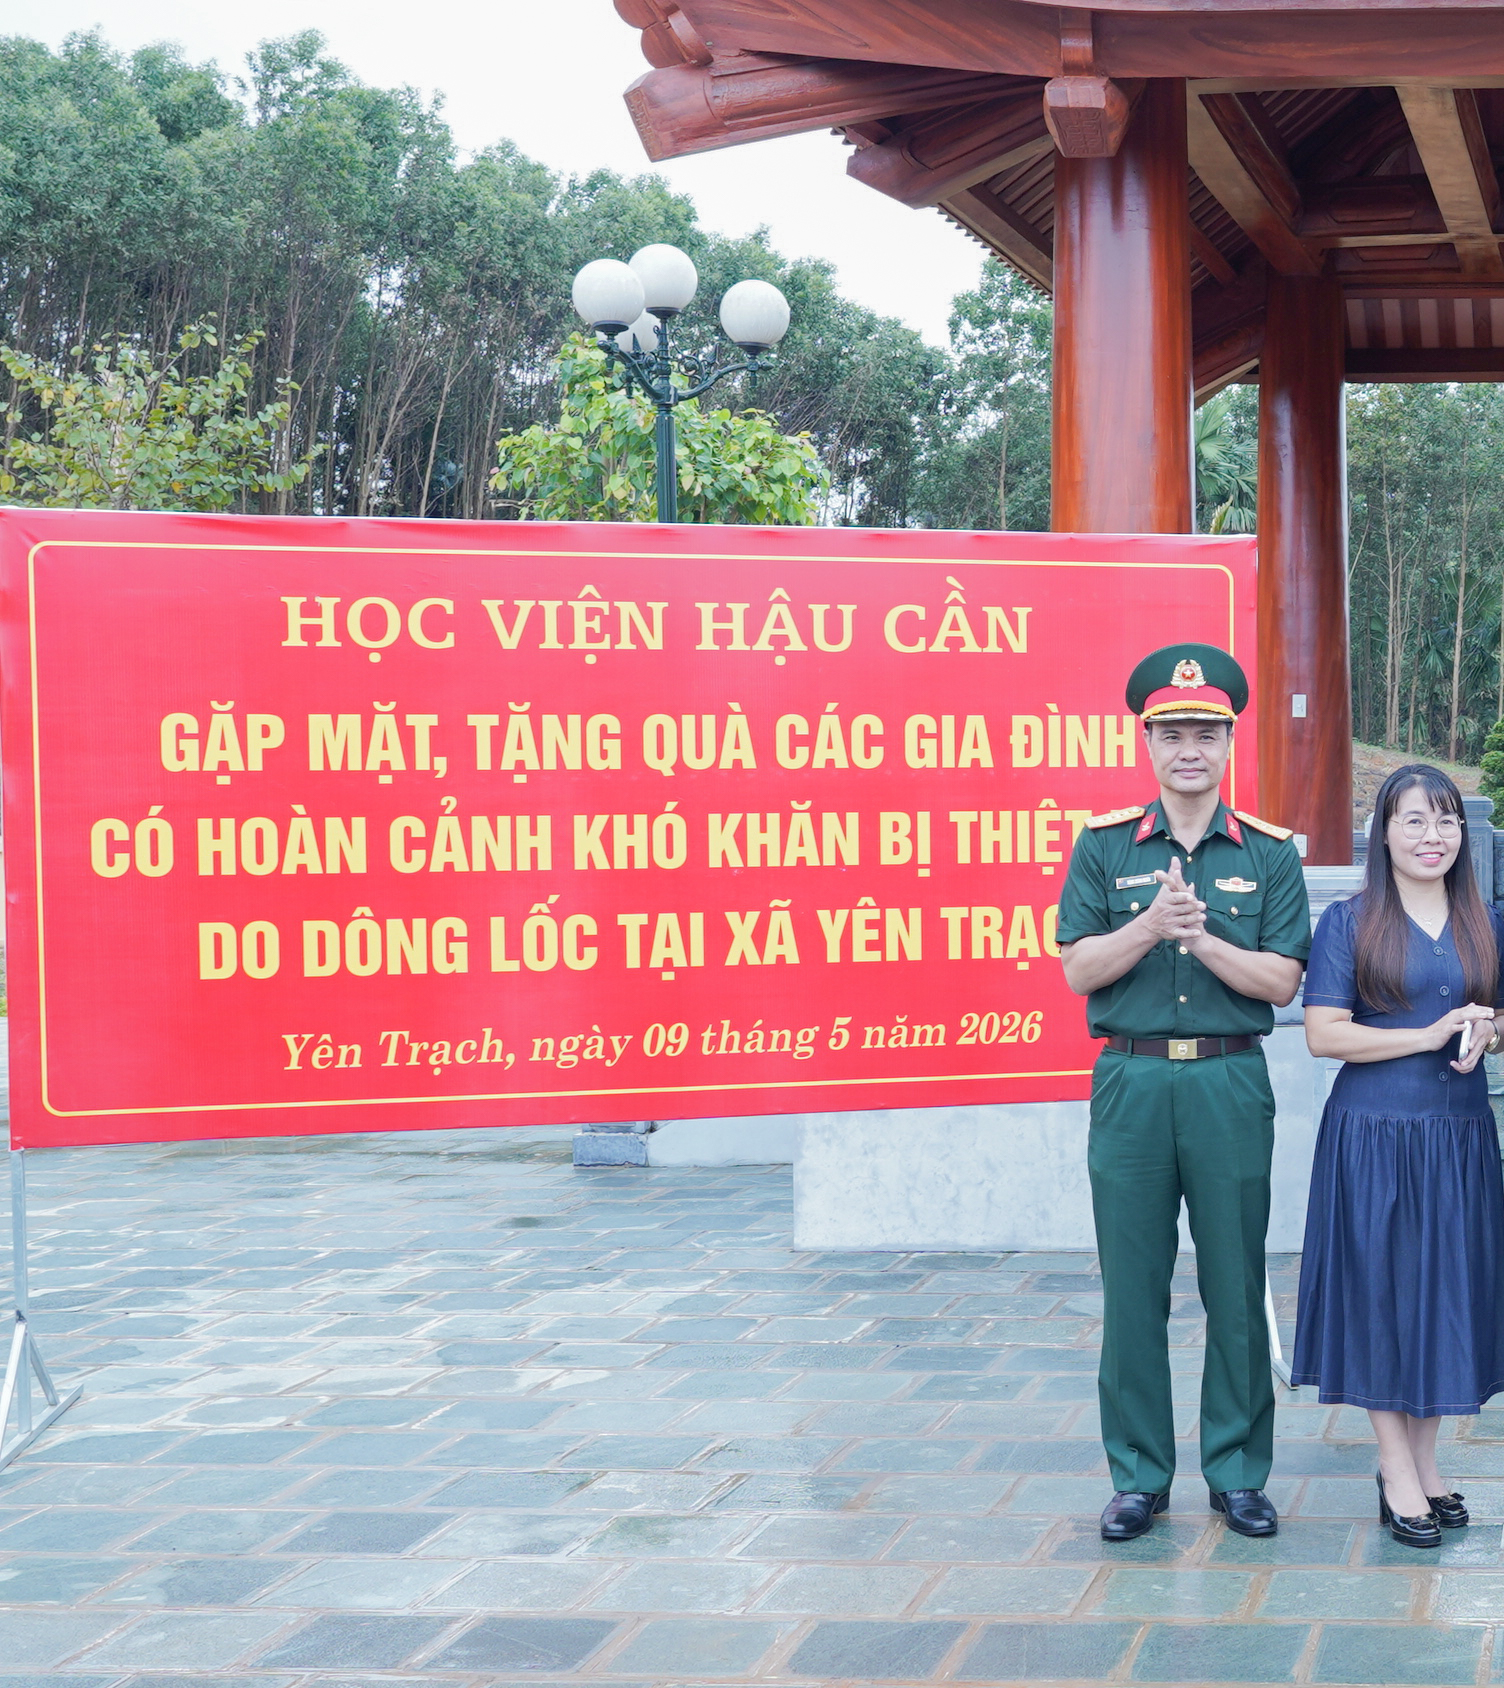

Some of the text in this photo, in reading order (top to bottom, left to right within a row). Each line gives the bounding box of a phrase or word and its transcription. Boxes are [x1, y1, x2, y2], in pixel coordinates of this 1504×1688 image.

[281, 576, 1033, 666] HỌC VIỆN HẬU CẦN
[160, 700, 1136, 785] GẶP MẶT, TẶNG QUÀ CÁC GIA ĐÌNH
[90, 805, 174, 878] CÓ
[197, 804, 367, 876] HOÀN
[389, 796, 552, 871] CẢNH
[573, 801, 687, 871] KHÓ
[708, 800, 860, 868] KHĂN
[880, 811, 931, 878] BỊ
[198, 920, 280, 980] DO
[302, 906, 469, 978] DÔNG
[490, 894, 598, 973] LỐC
[617, 912, 704, 981] TẠI
[724, 898, 800, 967] XÃ
[817, 896, 922, 964] YÊN
[281, 1010, 1044, 1076] Yên Trạch, ngày 09 tháng 5 năm 2026
